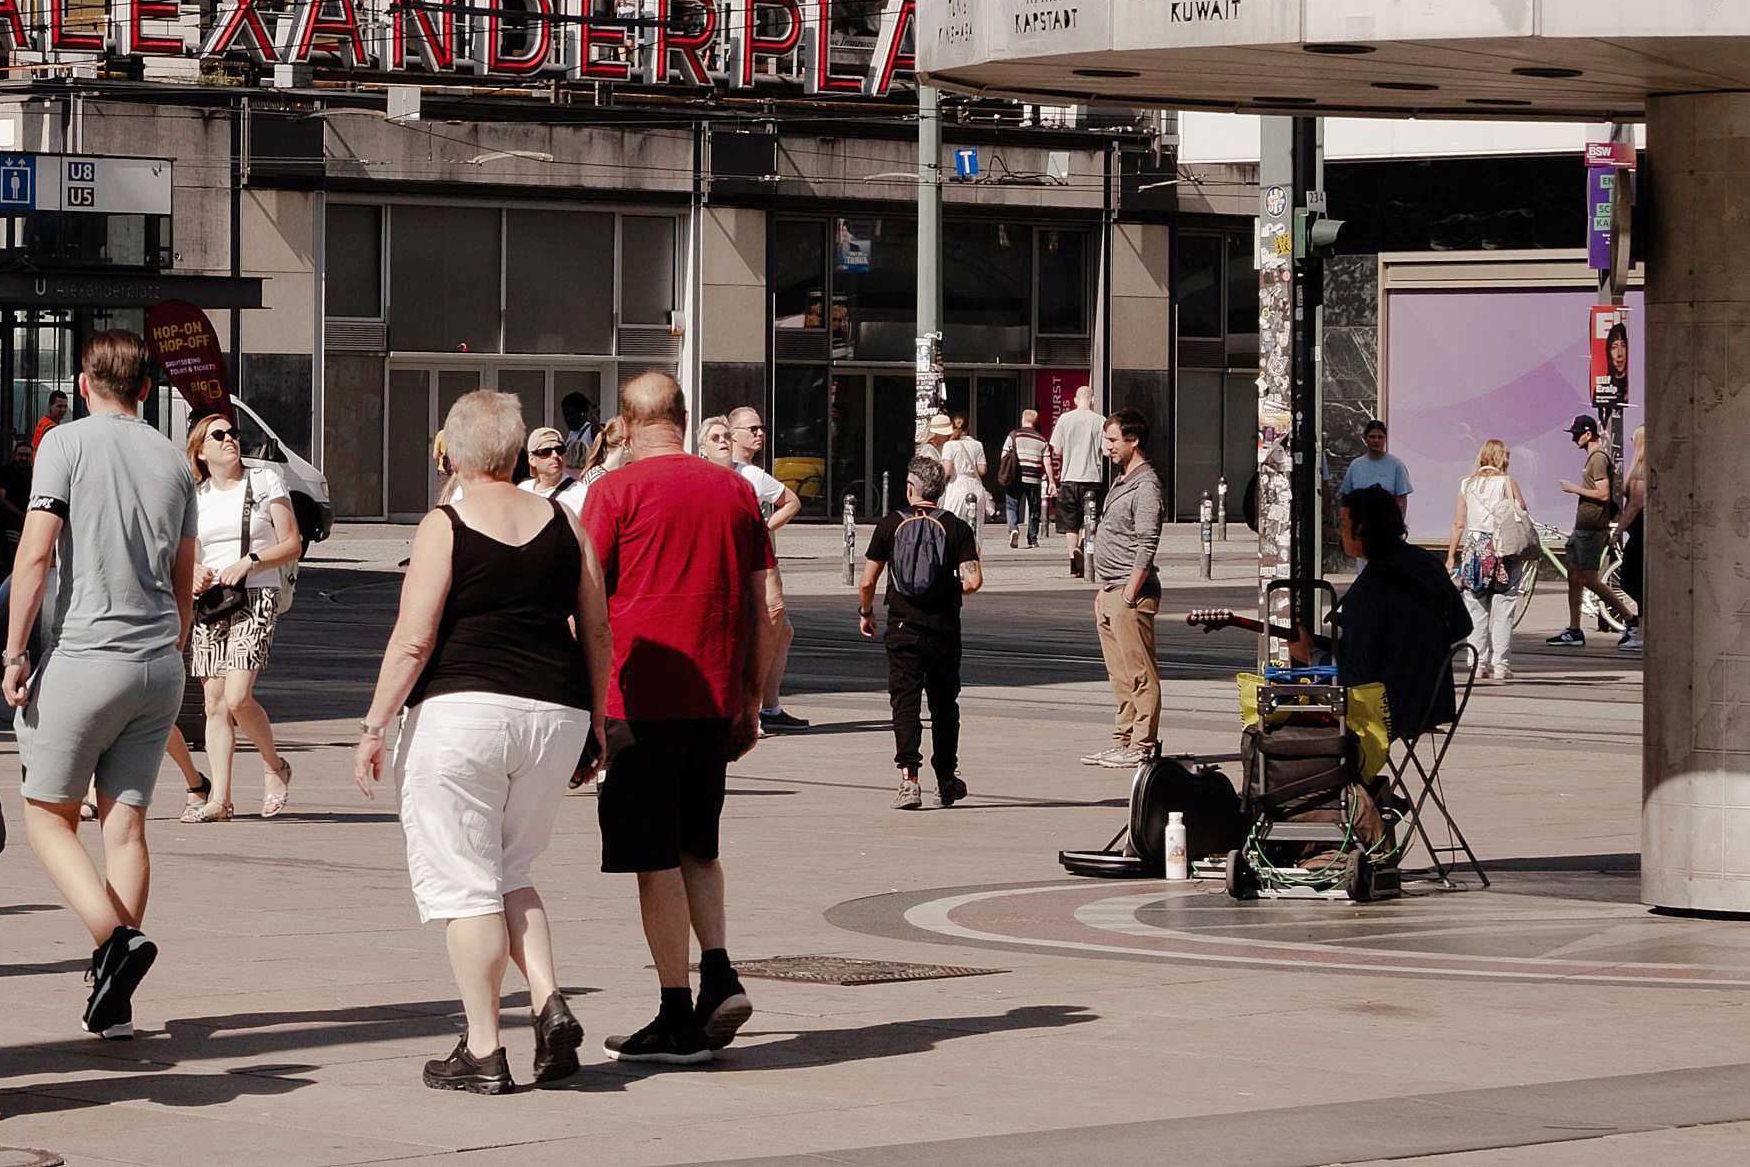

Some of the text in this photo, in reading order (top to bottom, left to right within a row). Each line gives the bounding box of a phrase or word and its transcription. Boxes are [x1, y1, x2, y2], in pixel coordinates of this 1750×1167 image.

[1171, 0, 1241, 22] KUWAIT
[1015, 8, 1078, 34] KAPSTADT
[1589, 146, 1611, 157] BSW
[70, 163, 94, 180] U8
[70, 188, 94, 205] U5
[1310, 192, 1324, 204] 234
[35, 277, 47, 296] U
[153, 321, 203, 341] HOP-ON
[159, 334, 210, 353] HOP-OFF
[190, 381, 207, 392] BIG
